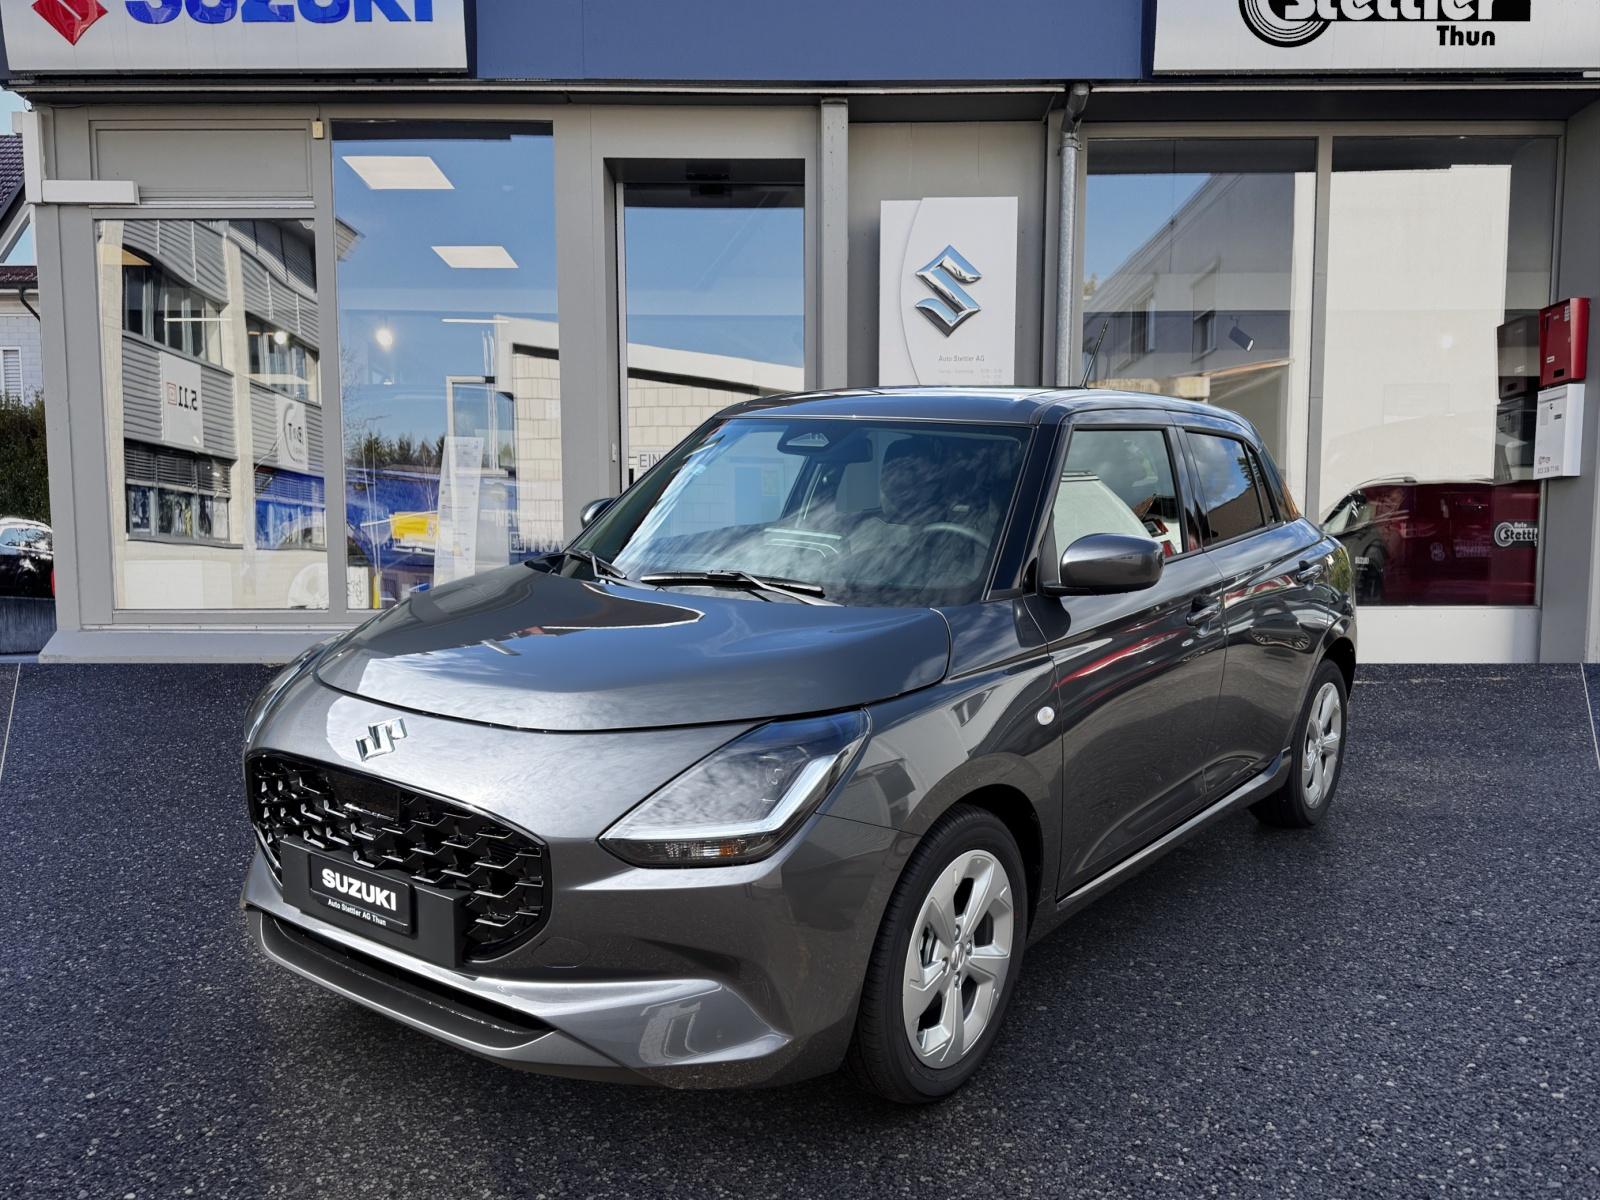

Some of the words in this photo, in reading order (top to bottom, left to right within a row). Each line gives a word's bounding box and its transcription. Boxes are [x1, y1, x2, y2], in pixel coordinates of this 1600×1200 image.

[1437, 25, 1495, 46] Thun
[322, 868, 396, 911] SUZUKI
[327, 898, 340, 909] Auto
[362, 911, 371, 921] AG
